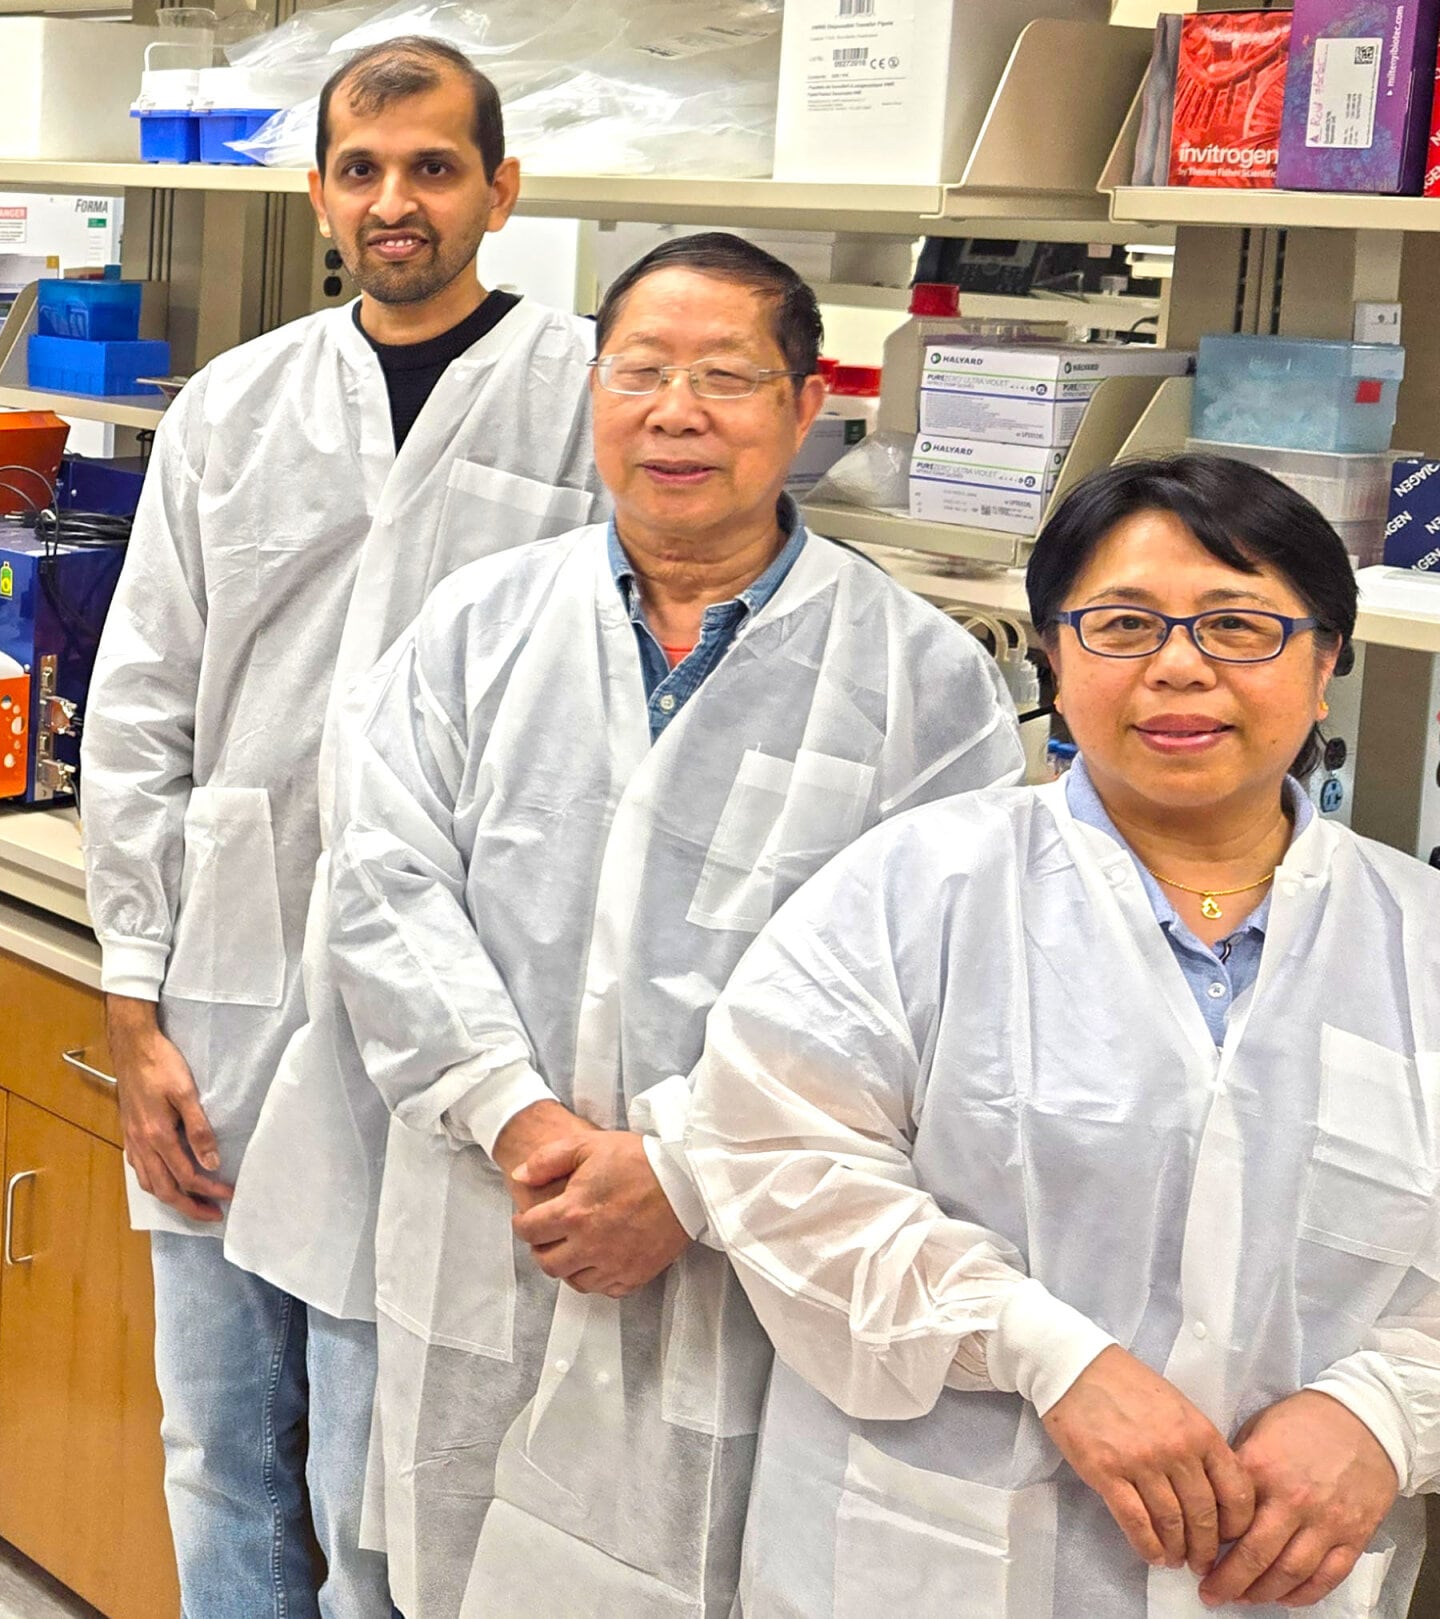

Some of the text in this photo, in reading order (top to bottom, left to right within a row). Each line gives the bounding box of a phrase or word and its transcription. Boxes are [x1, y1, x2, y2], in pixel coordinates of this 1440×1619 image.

[1386, 5, 1404, 87] miltenyibiotec.com
[1178, 142, 1279, 169] invitrogen
[75, 198, 109, 214] FORMA
[943, 356, 984, 366] HALYARD
[932, 445, 973, 456] HALYARD
